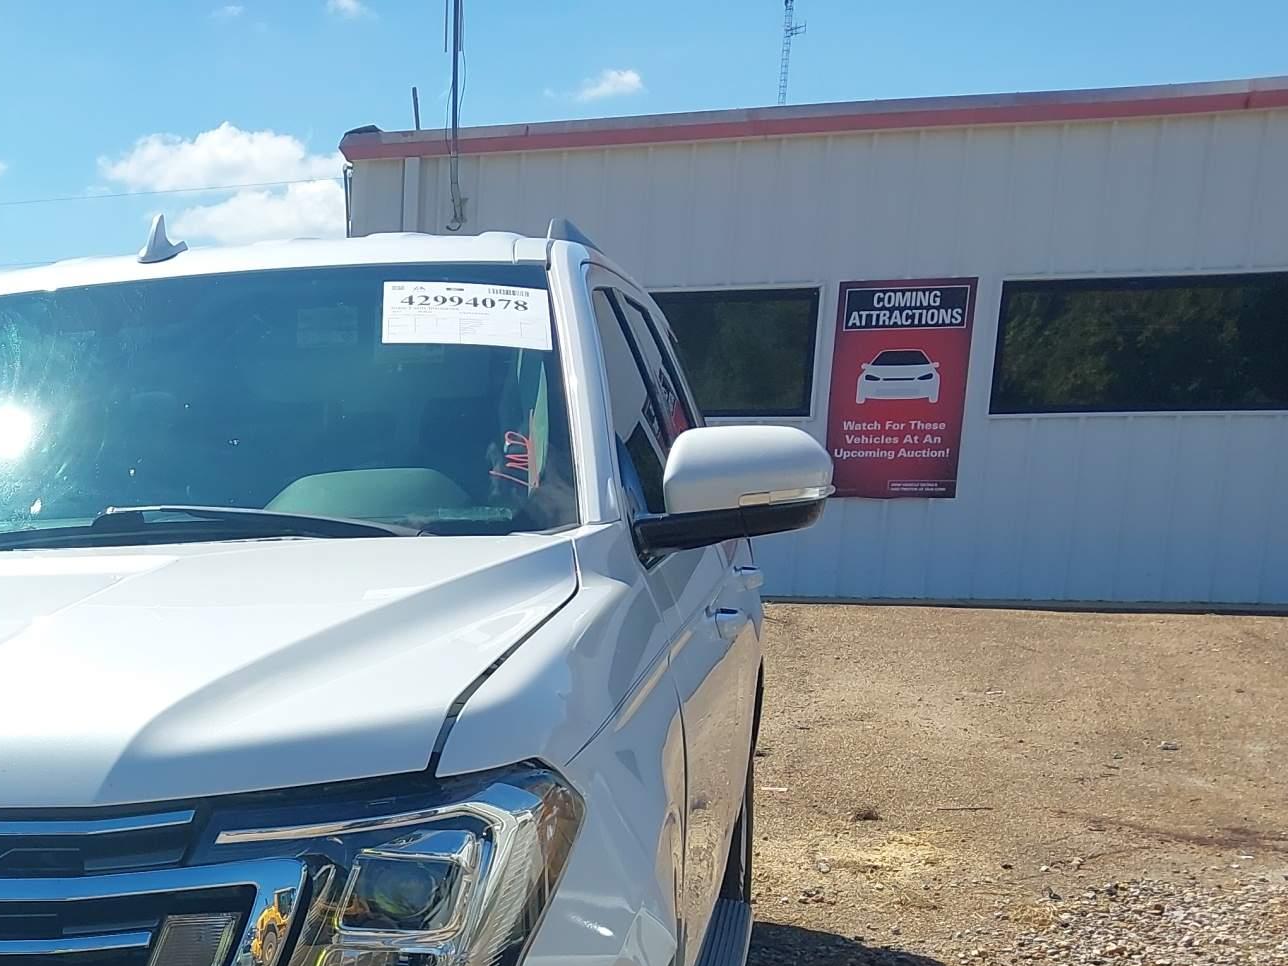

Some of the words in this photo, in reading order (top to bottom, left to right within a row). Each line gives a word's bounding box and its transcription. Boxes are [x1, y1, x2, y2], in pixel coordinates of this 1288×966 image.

[400, 294, 529, 312] 42994078
[873, 290, 941, 308] COMING
[847, 308, 962, 327] ATTRACTIONS
[843, 420, 881, 431] Watch
[885, 420, 906, 430] For
[909, 420, 946, 430] These
[845, 434, 899, 445] Vehicles
[903, 434, 918, 444] At
[923, 434, 941, 444] An
[834, 448, 895, 460] Upcoming
[897, 448, 950, 458] Auction!
